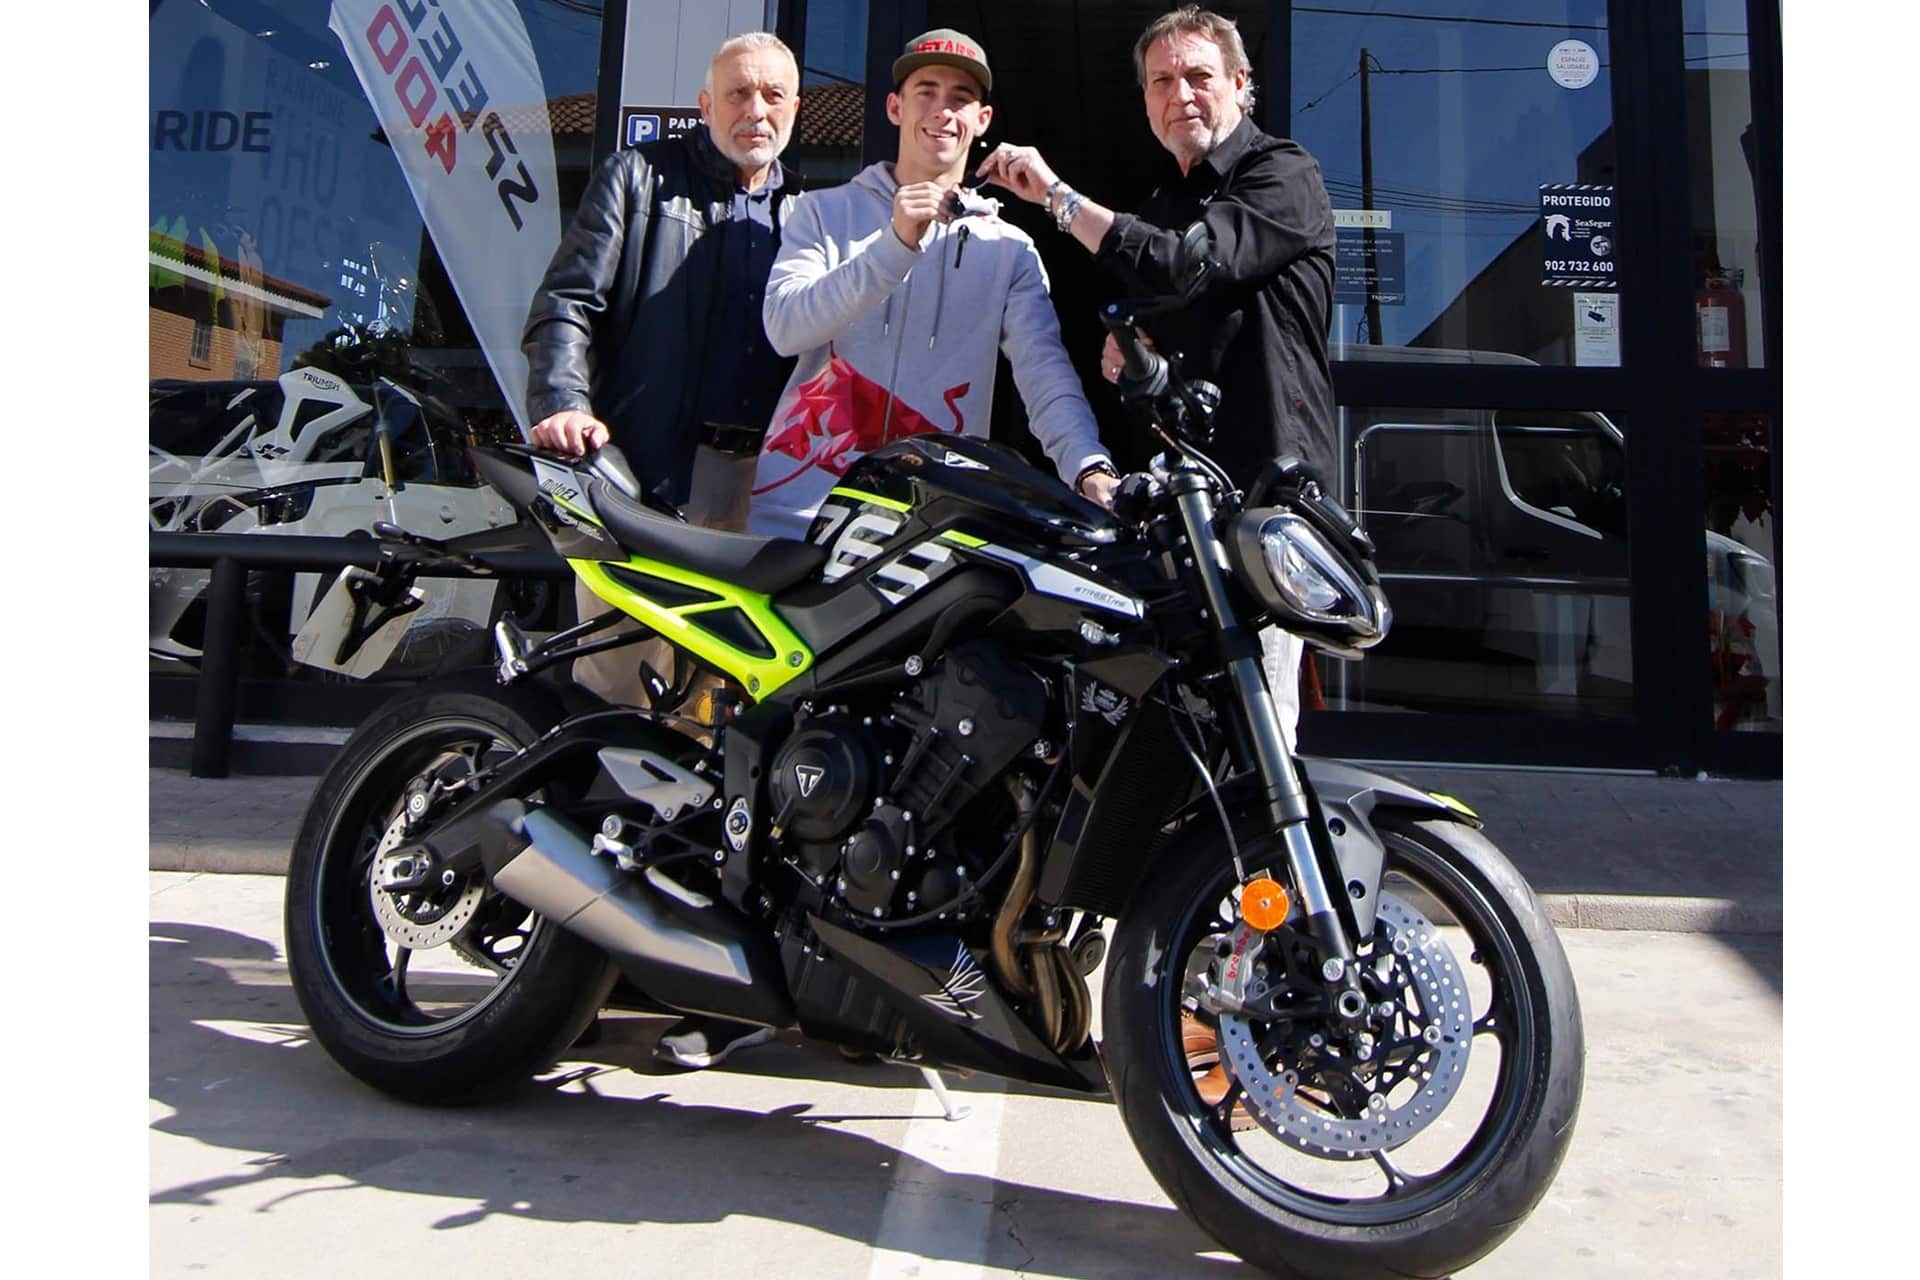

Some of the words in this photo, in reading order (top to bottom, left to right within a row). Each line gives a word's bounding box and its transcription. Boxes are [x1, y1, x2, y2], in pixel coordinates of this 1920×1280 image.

[153, 110, 274, 153] RIDE
[1542, 195, 1611, 207] PROTEGIDO
[1544, 260, 1566, 271] 902
[1568, 260, 1590, 271] 732
[1592, 261, 1614, 272] 600
[303, 372, 341, 392] TRIUMPH
[1226, 930, 1252, 980] brembo
